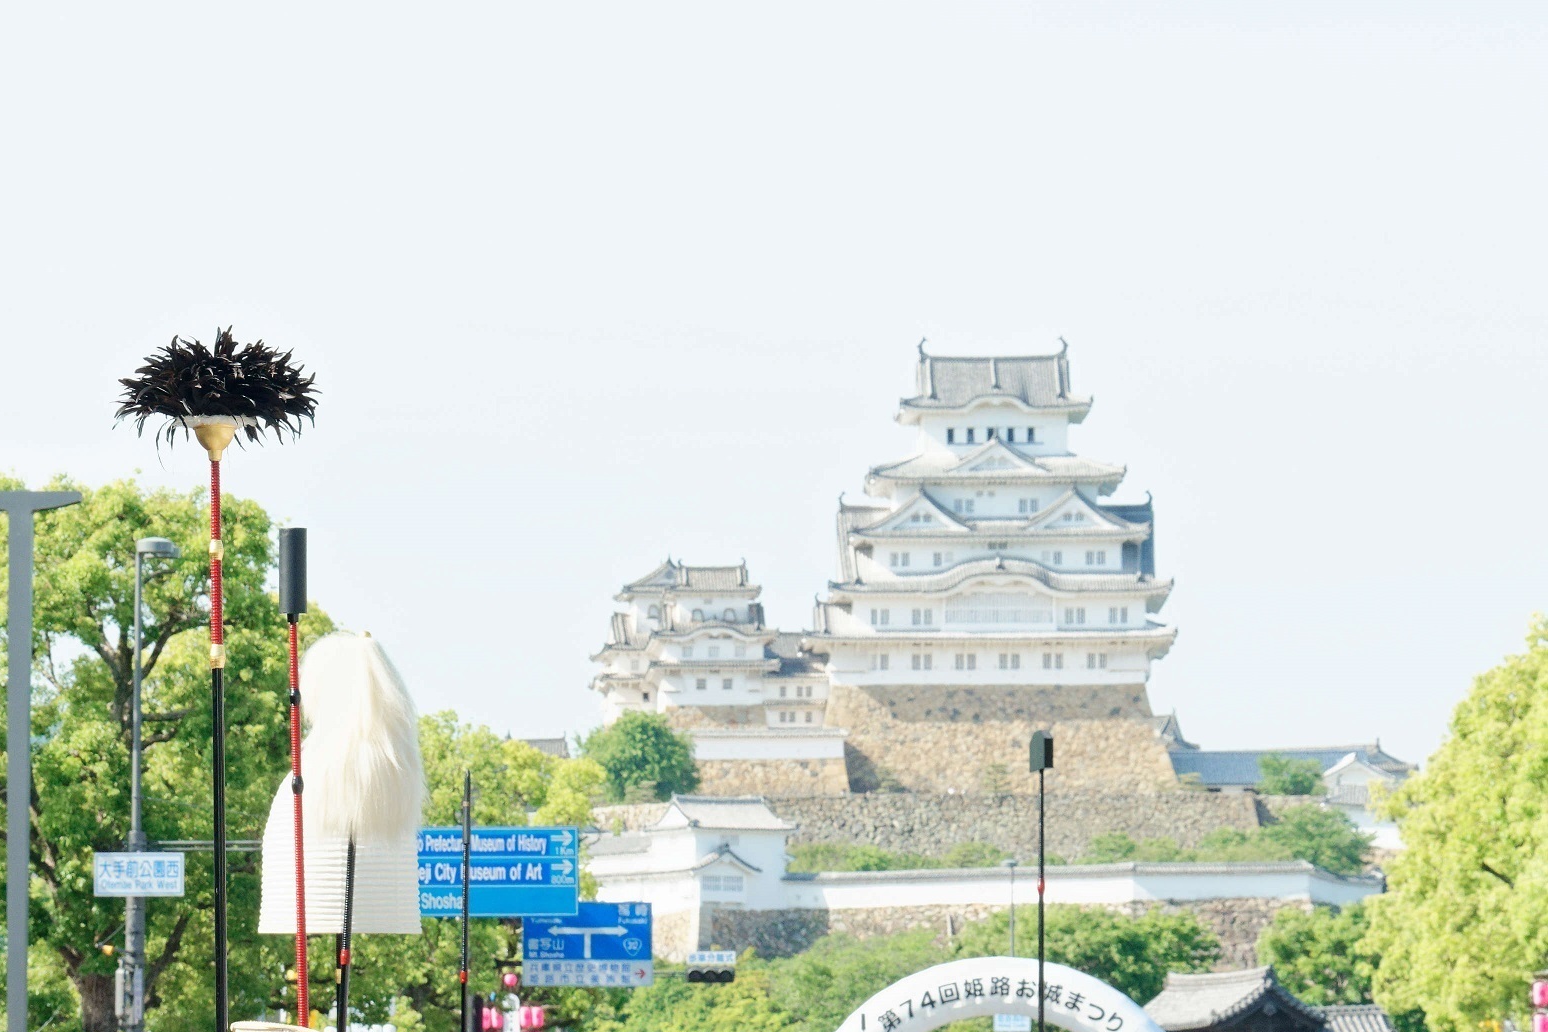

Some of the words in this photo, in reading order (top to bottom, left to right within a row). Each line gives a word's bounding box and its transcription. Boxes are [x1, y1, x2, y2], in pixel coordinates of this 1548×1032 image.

[425, 834, 463, 852] Prefectur
[506, 834, 516, 852] of
[517, 834, 547, 855] History
[99, 860, 179, 878] 大手前公園西
[435, 863, 456, 883] City
[509, 863, 522, 881] of
[525, 863, 543, 881] Art
